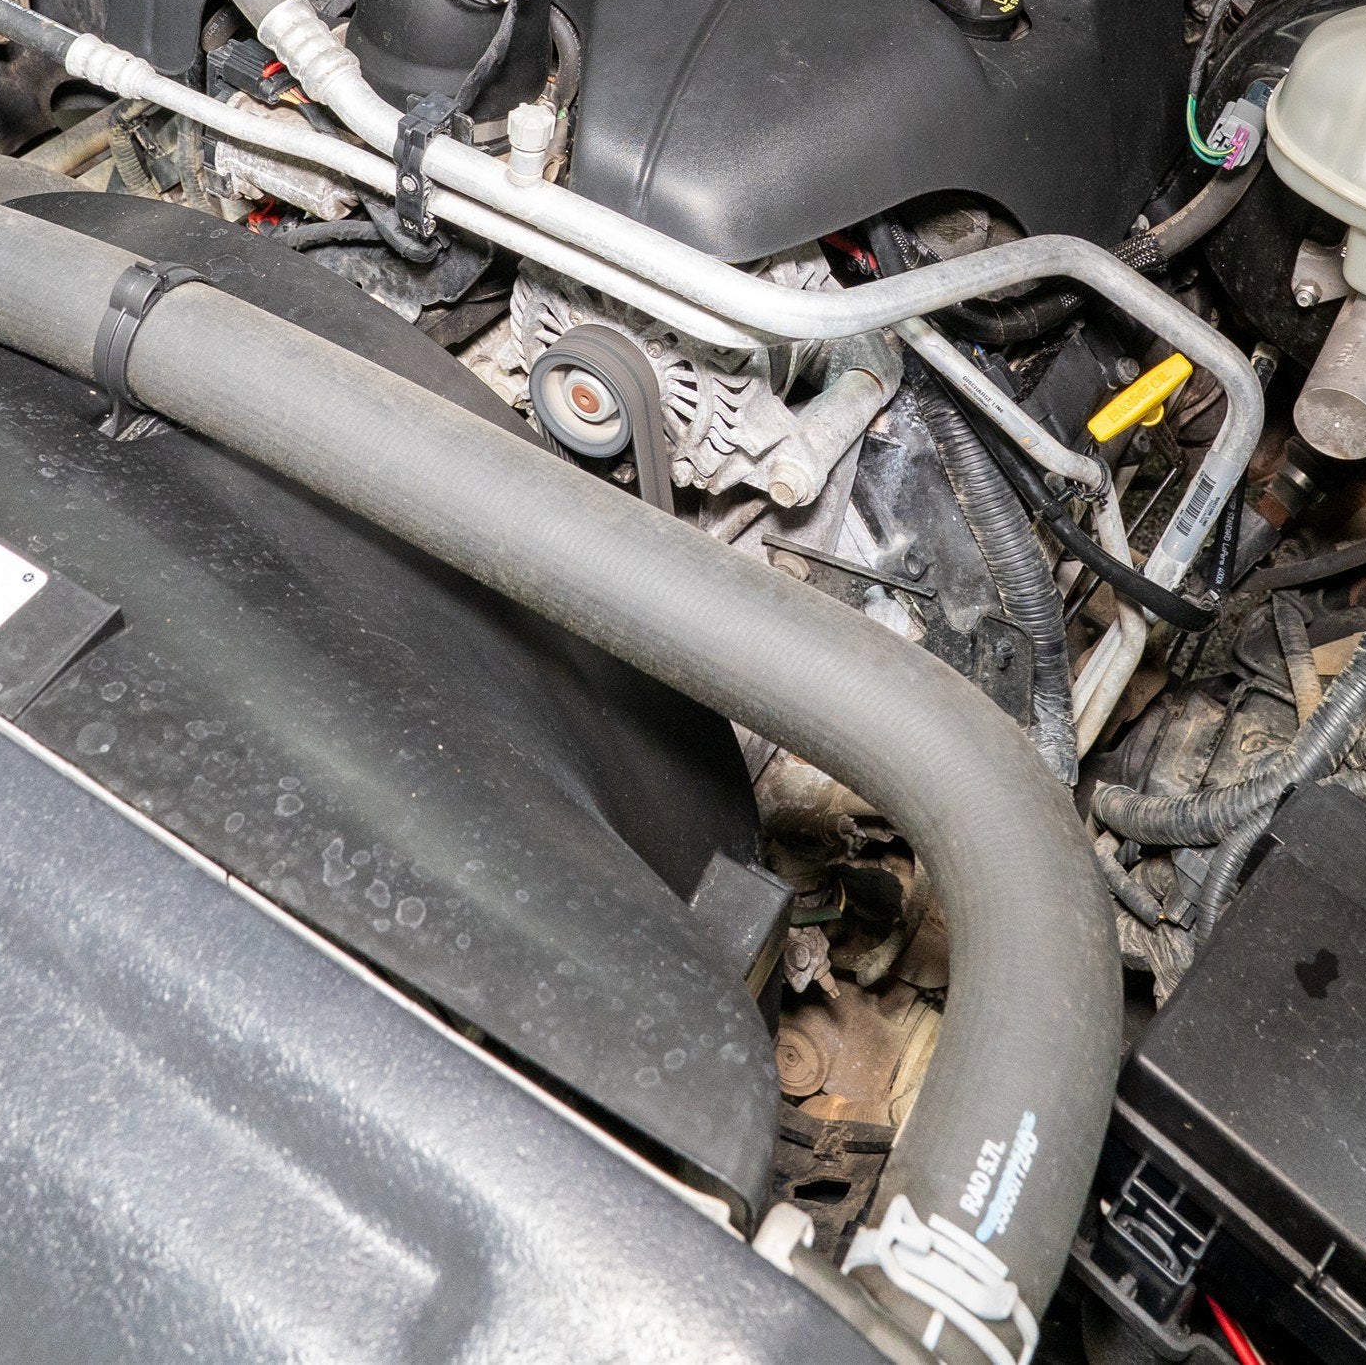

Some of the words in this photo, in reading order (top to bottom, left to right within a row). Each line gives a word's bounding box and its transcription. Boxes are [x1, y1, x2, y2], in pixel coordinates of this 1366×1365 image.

[1169, 208, 1188, 226] AVON
[959, 374, 995, 403] DISCHARGE
[990, 401, 1005, 413] LINE
[1106, 383, 1153, 423] ENGINE
[1147, 367, 1173, 391] OIL
[1213, 510, 1243, 543] STANDARD
[959, 1170, 992, 1217] RAD
